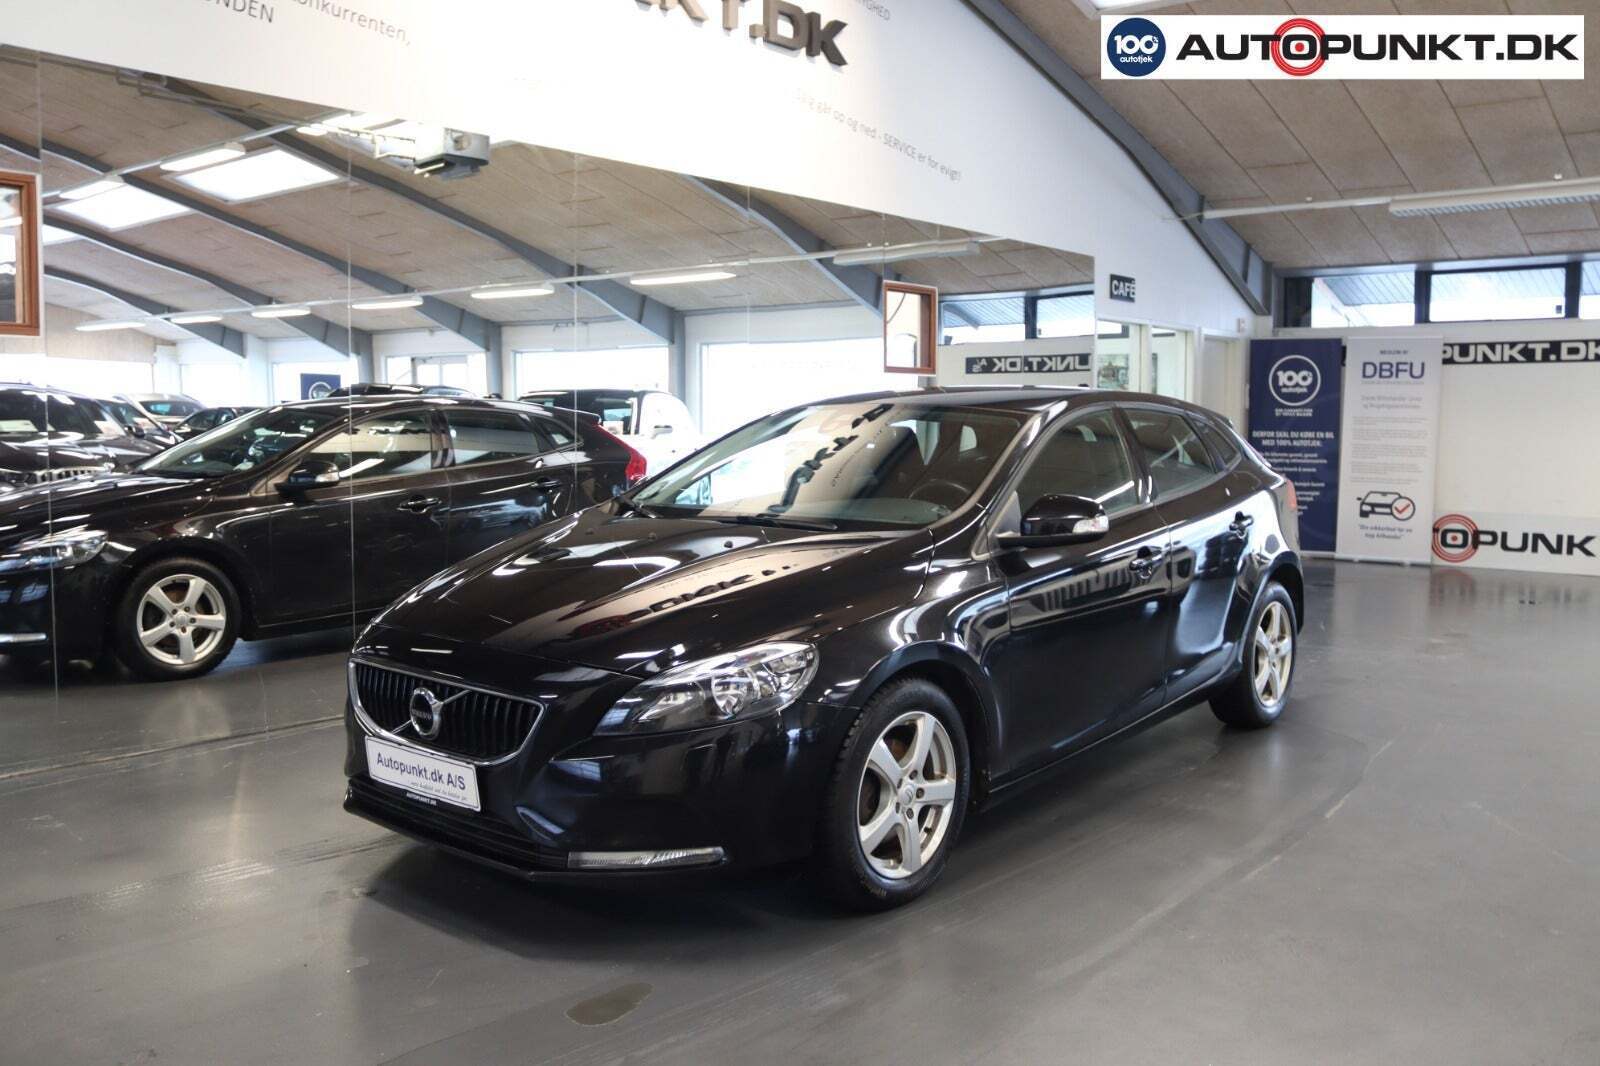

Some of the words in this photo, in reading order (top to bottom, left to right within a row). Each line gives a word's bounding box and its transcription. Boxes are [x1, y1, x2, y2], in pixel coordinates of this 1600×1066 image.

[883, 133, 917, 160] SERVICE
[1362, 361, 1425, 379] DBFU
[1433, 526, 1597, 558] OPUNK
[377, 752, 445, 784] Autopunkt.dk
[447, 773, 466, 790] A/S
